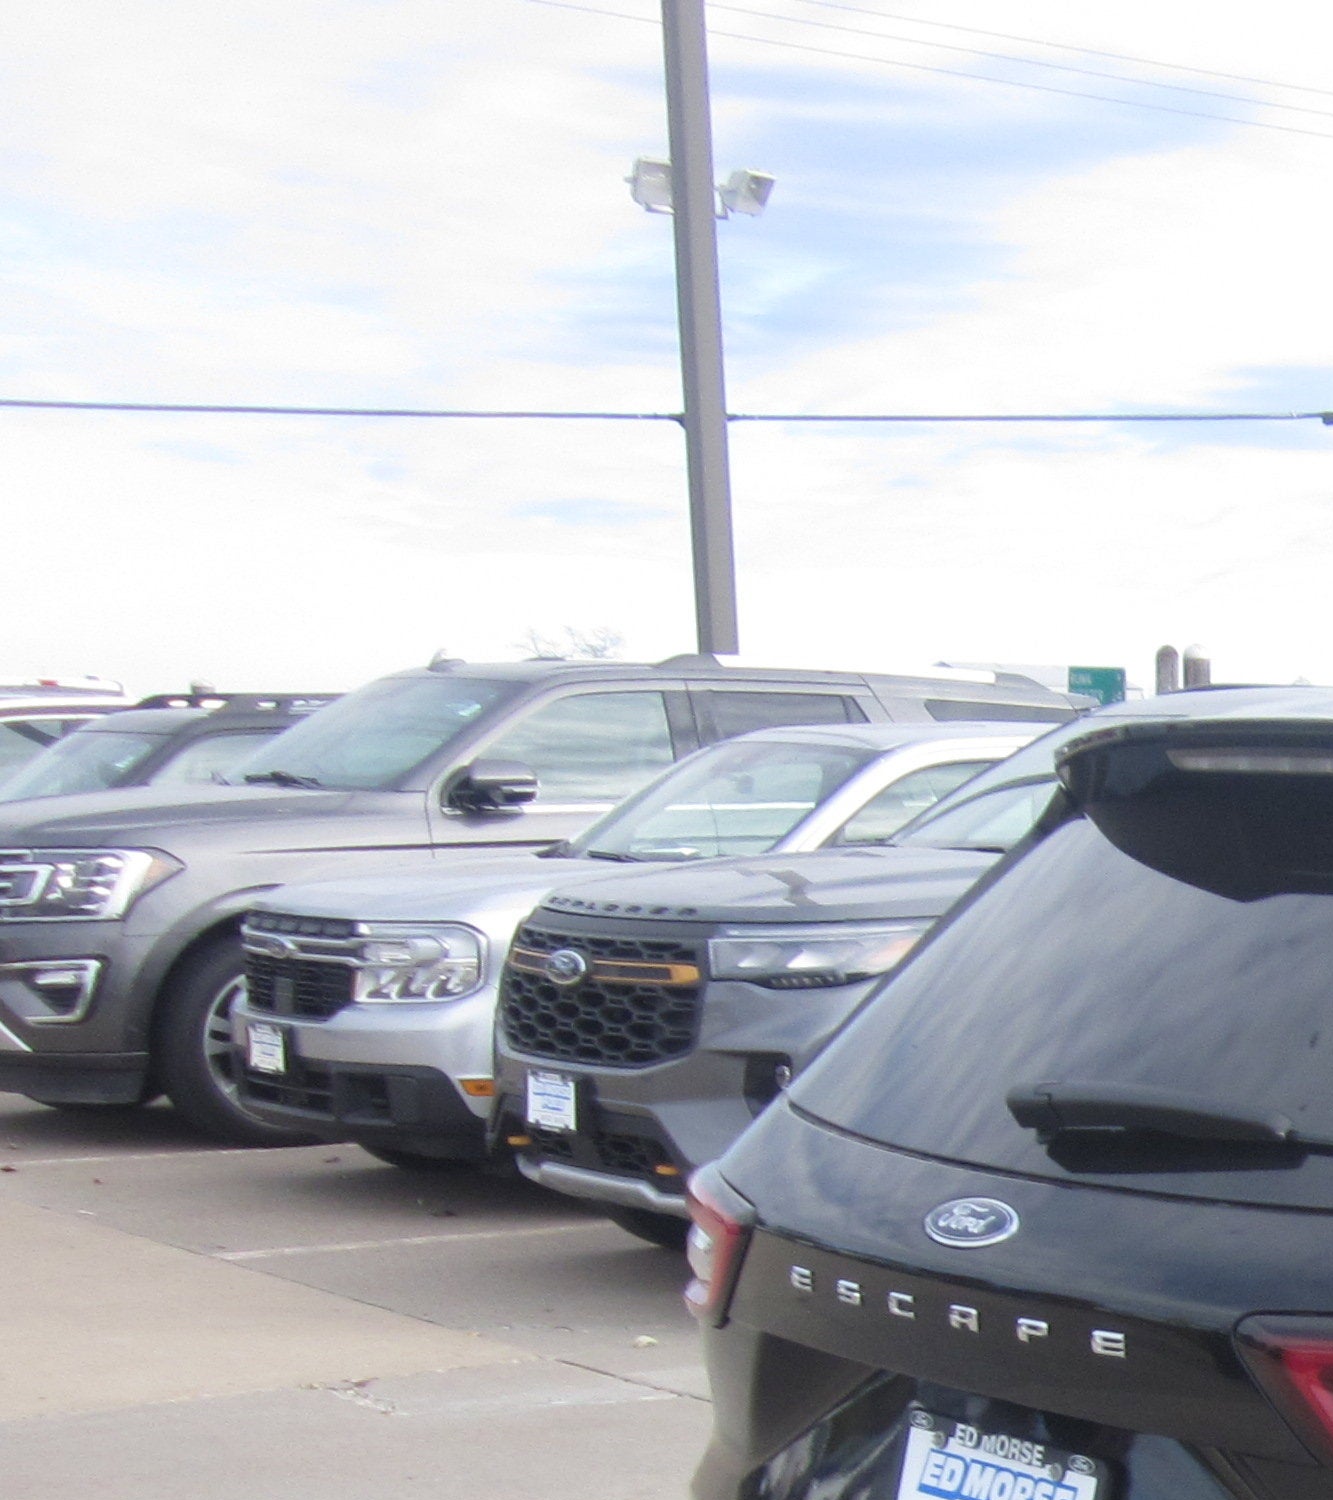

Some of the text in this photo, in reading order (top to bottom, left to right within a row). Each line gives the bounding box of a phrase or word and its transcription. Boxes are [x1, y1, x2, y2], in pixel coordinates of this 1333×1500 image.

[789, 1265, 1127, 1359] ESCAPE
[955, 1423, 979, 1447] ED
[979, 1433, 1047, 1467] MORSE
[919, 1449, 968, 1496] ED
